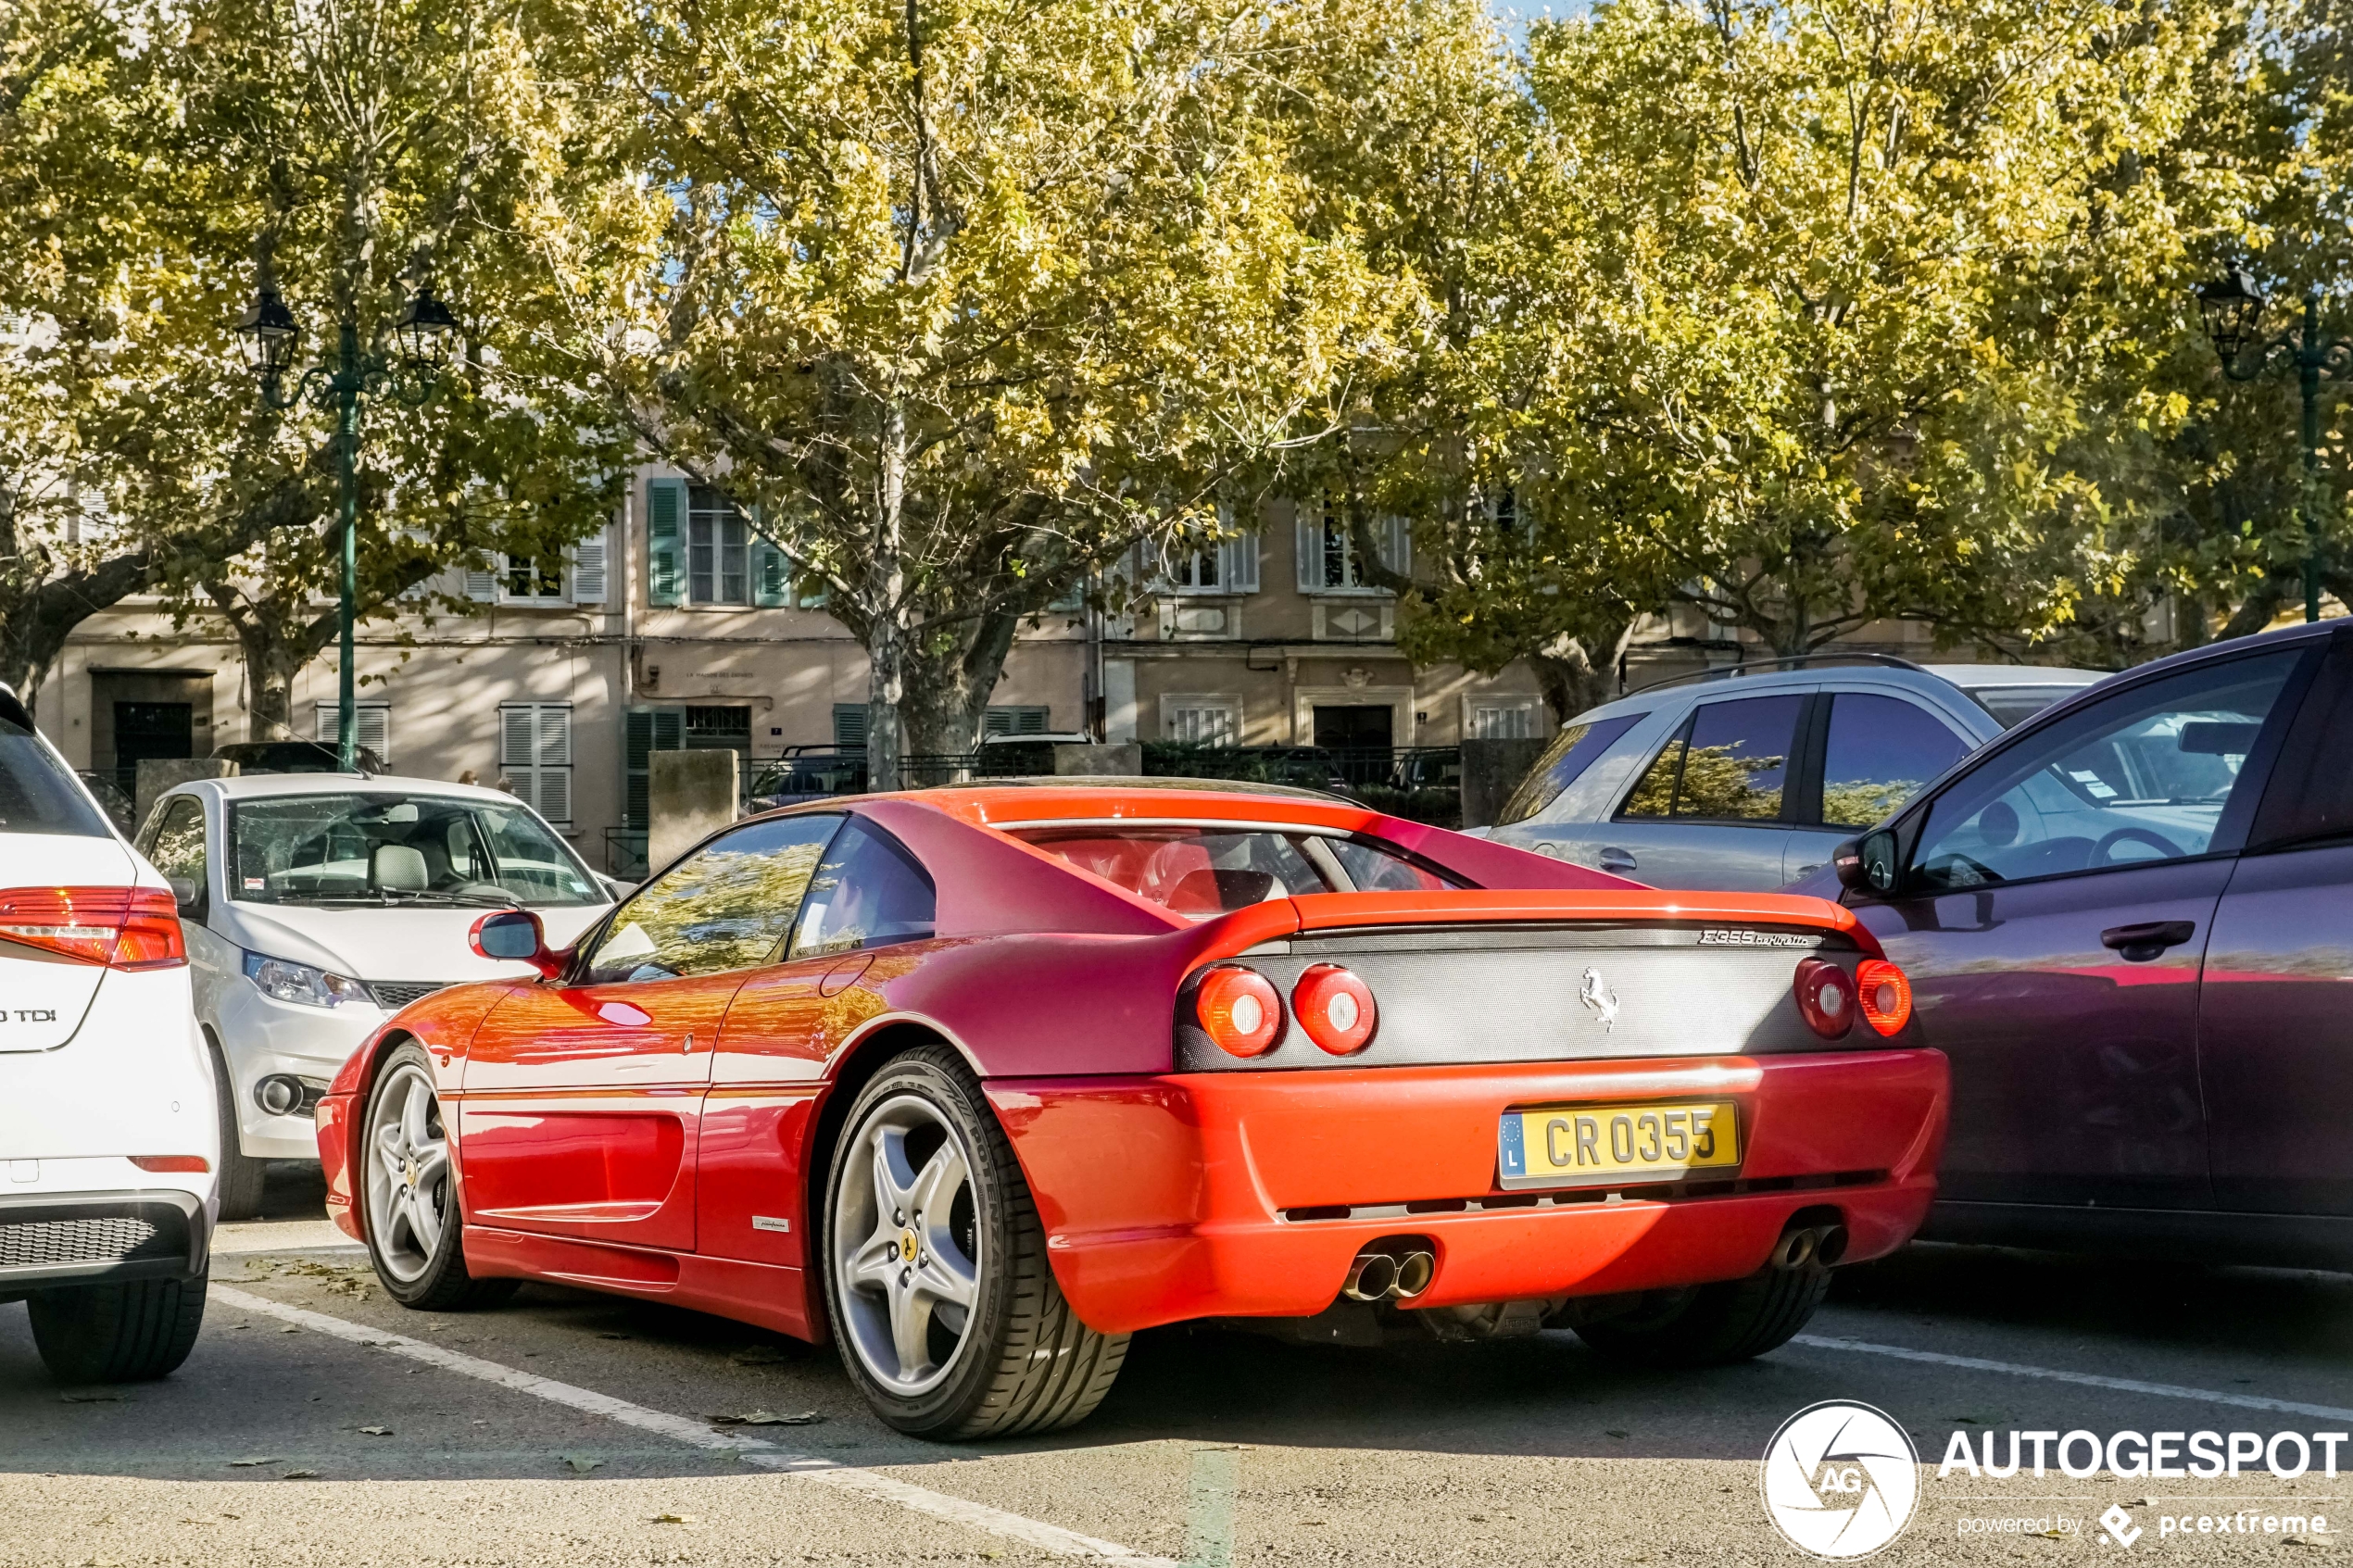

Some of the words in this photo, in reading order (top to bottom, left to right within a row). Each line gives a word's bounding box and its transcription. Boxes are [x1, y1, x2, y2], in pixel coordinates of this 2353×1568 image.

[14, 1010, 57, 1022] TDI
[1547, 1116, 1601, 1166] CR
[1611, 1110, 1716, 1163] 0355
[1508, 1150, 1517, 1167] L
[970, 1126, 1000, 1268] POTENZA
